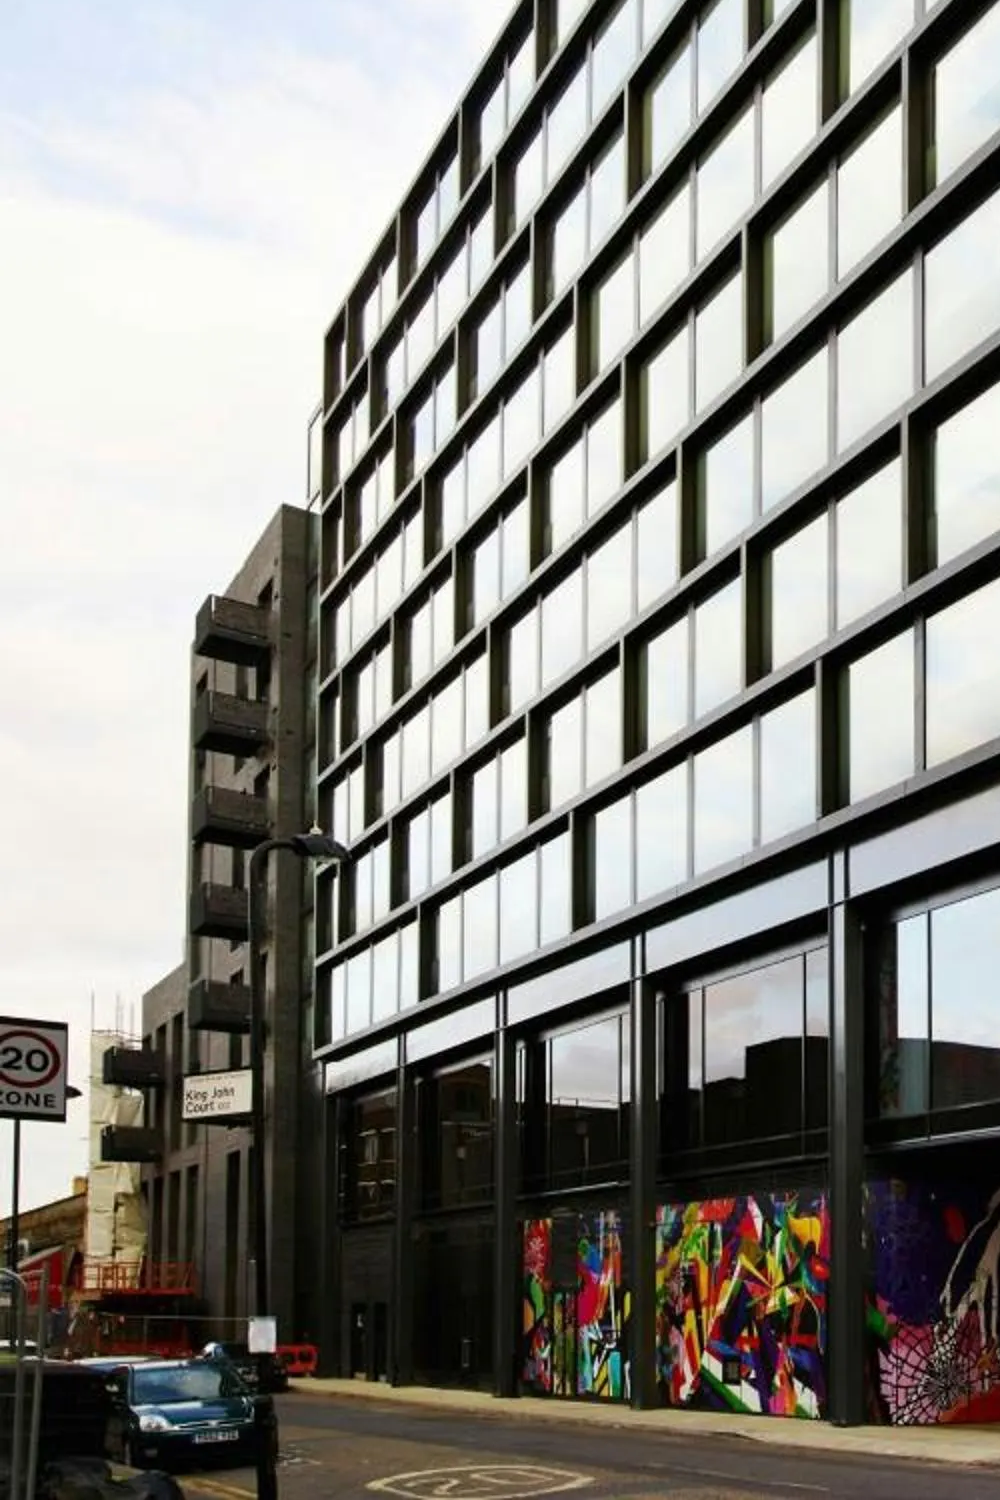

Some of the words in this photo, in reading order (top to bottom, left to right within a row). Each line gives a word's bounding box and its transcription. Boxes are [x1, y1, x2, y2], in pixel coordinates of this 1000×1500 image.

[1, 1046, 50, 1073] 20
[211, 1086, 235, 1099] John
[186, 1101, 215, 1113] Court
